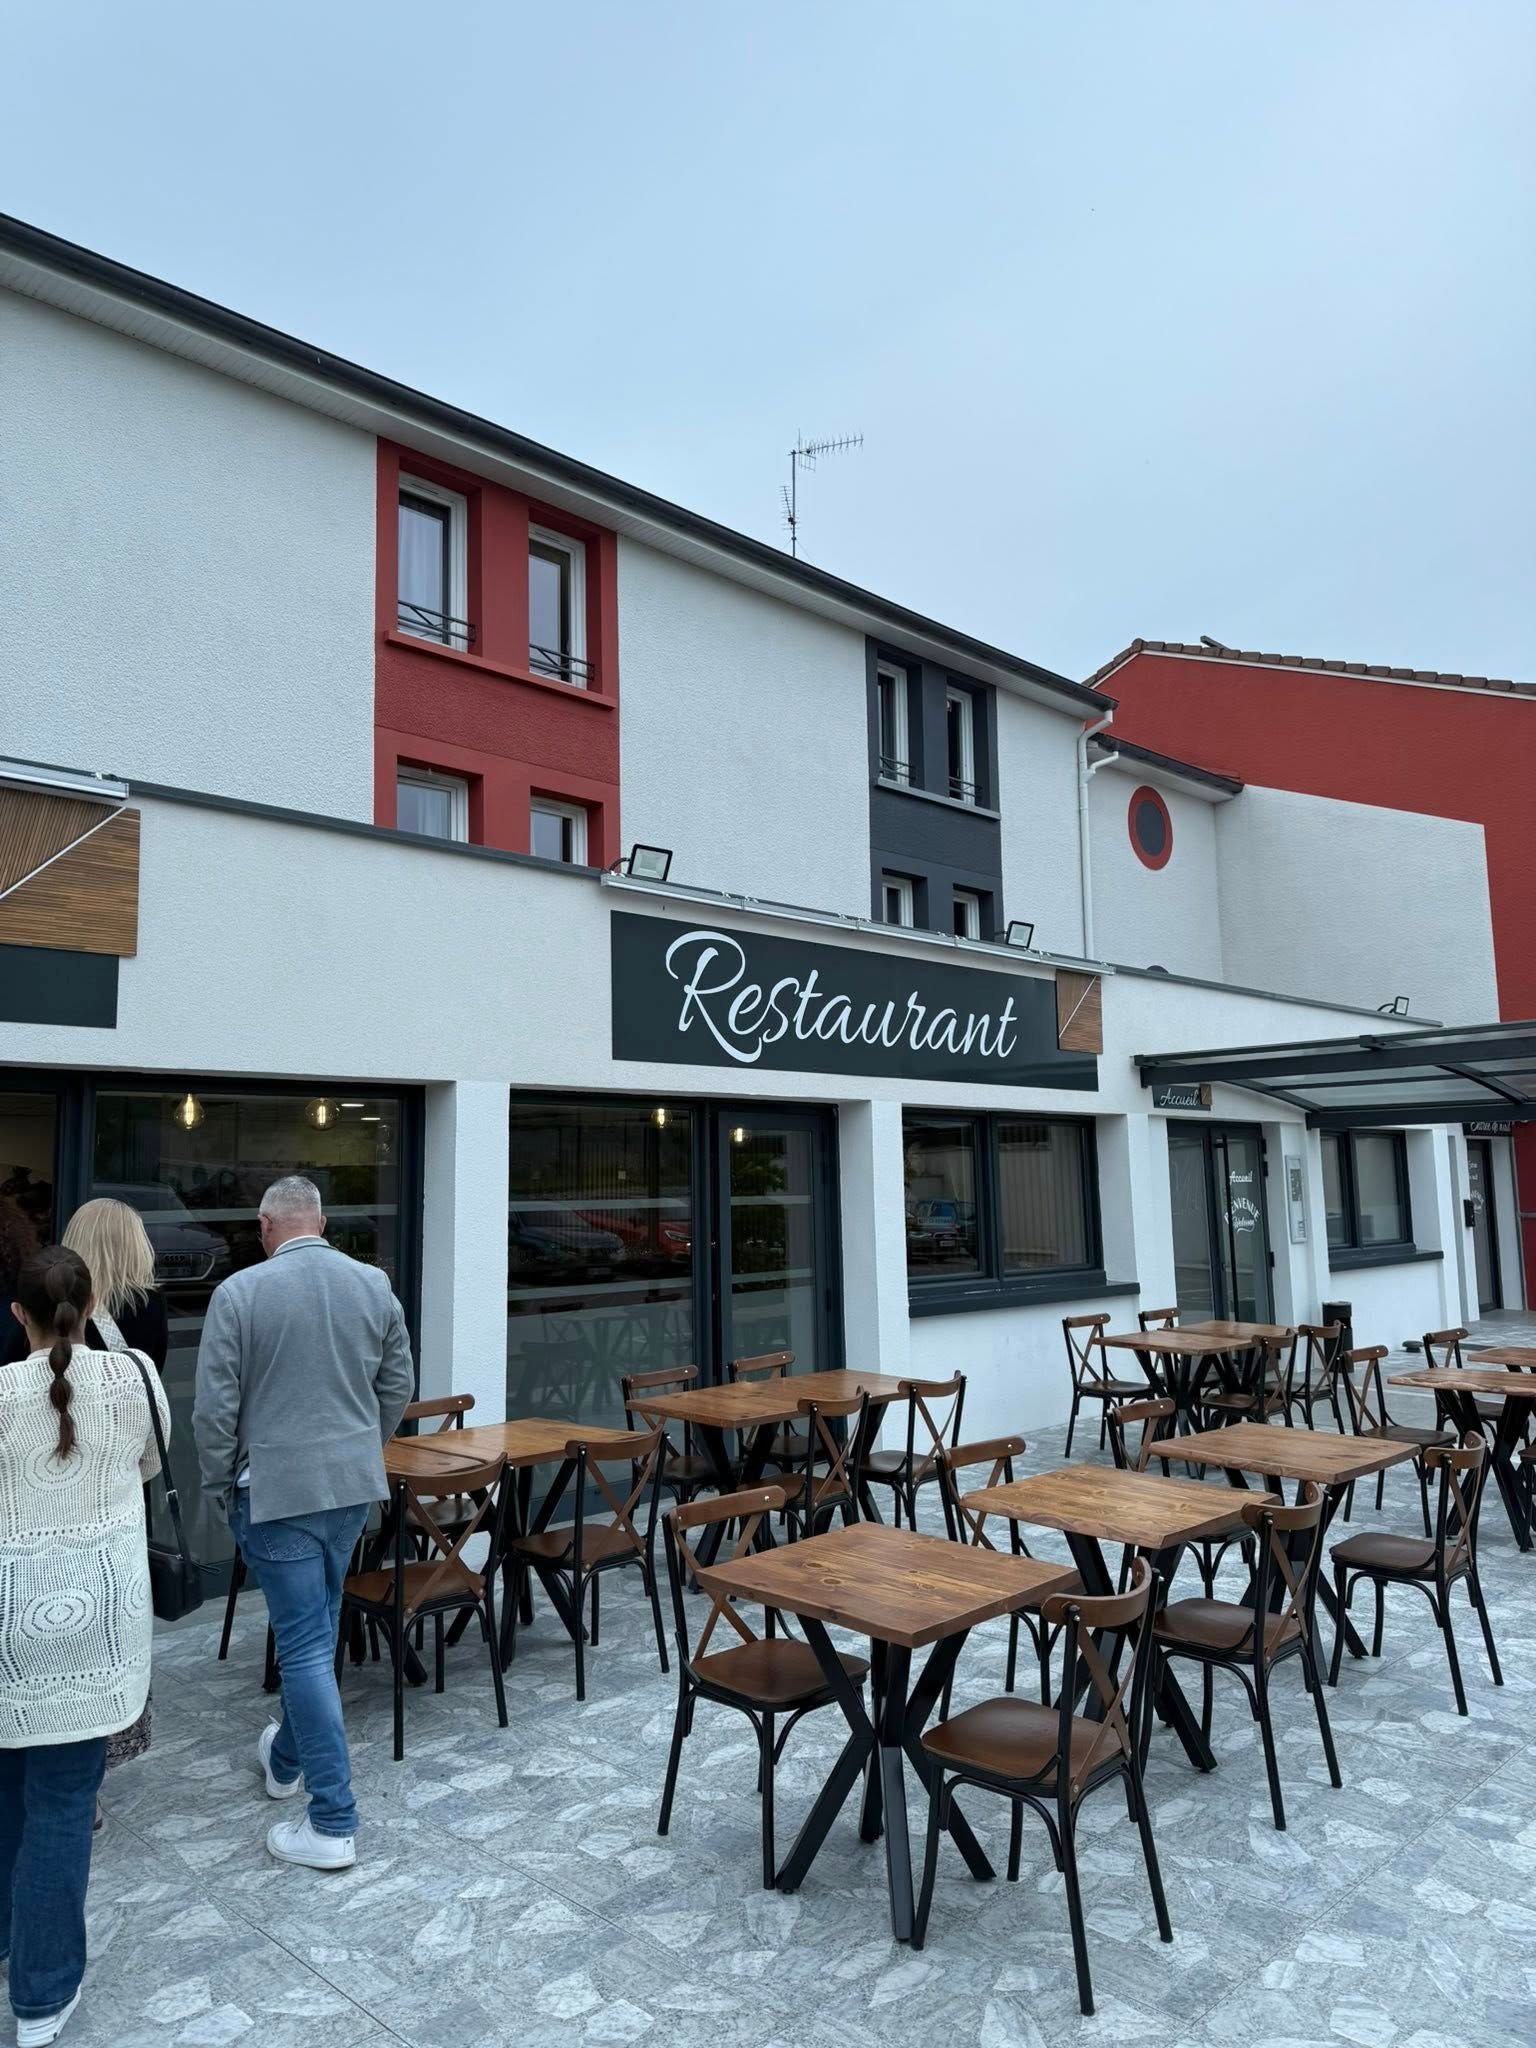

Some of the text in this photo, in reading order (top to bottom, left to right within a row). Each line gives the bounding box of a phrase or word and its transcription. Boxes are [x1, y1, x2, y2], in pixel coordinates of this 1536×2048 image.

[665, 930, 1018, 1063] Restaurant
[1160, 1088, 1198, 1106] Accueil
[1229, 1171, 1253, 1185] Accueil
